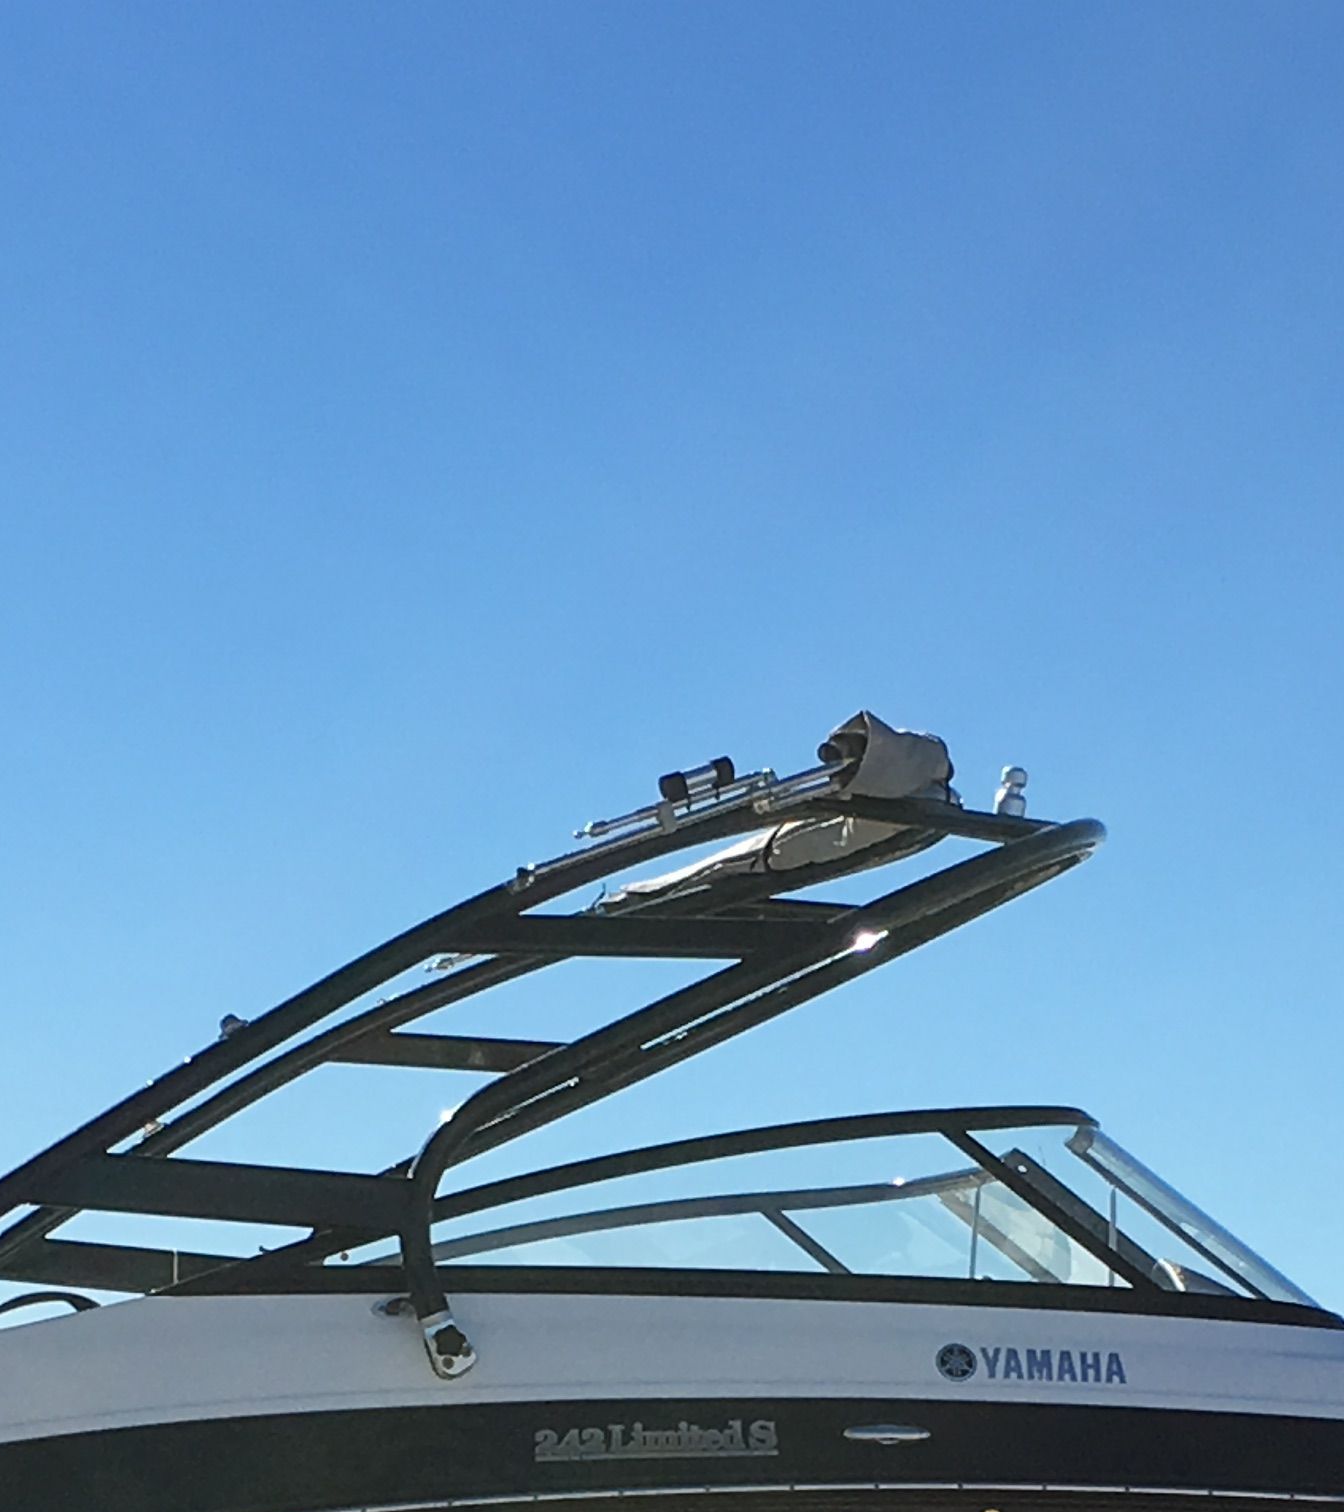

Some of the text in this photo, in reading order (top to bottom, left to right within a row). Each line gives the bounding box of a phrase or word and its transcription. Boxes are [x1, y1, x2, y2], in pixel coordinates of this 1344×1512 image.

[979, 1346, 1128, 1384] YAMAHA
[534, 1419, 779, 1455] 242 Limited S
